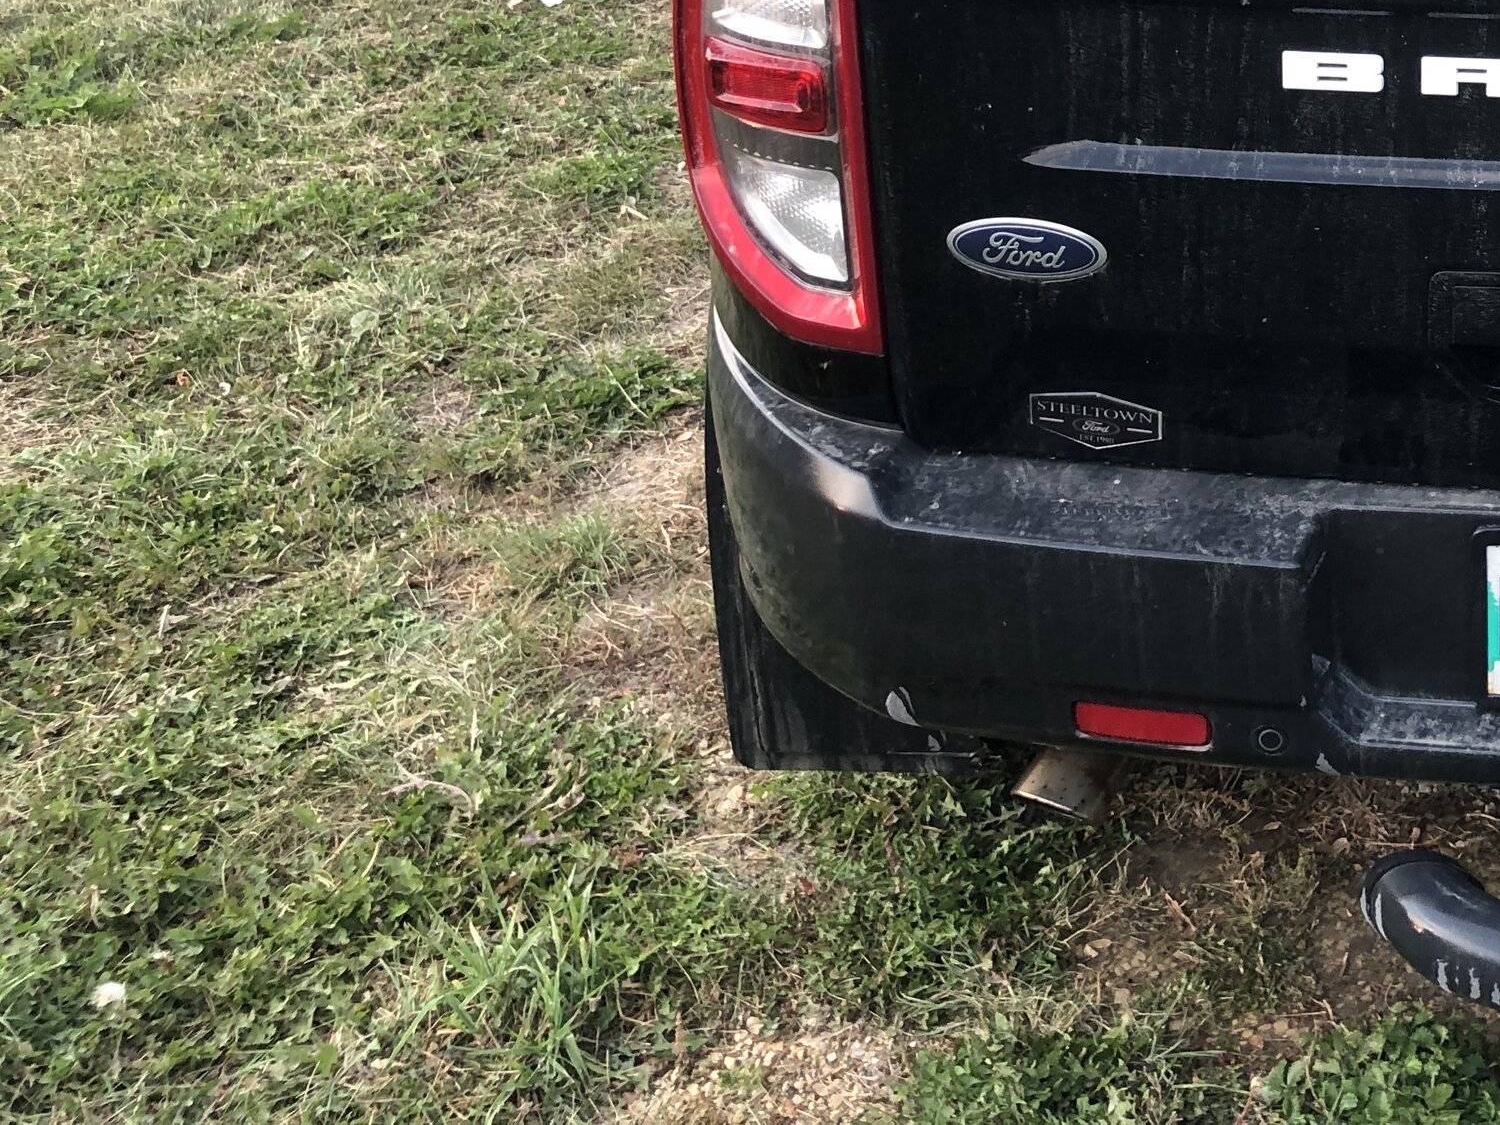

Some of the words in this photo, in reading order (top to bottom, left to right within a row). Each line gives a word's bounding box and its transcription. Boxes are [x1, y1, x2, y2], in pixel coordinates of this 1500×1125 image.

[982, 231, 1066, 269] Ford
[1037, 400, 1153, 424] STEELTOWN
[1081, 420, 1110, 433] Ford
